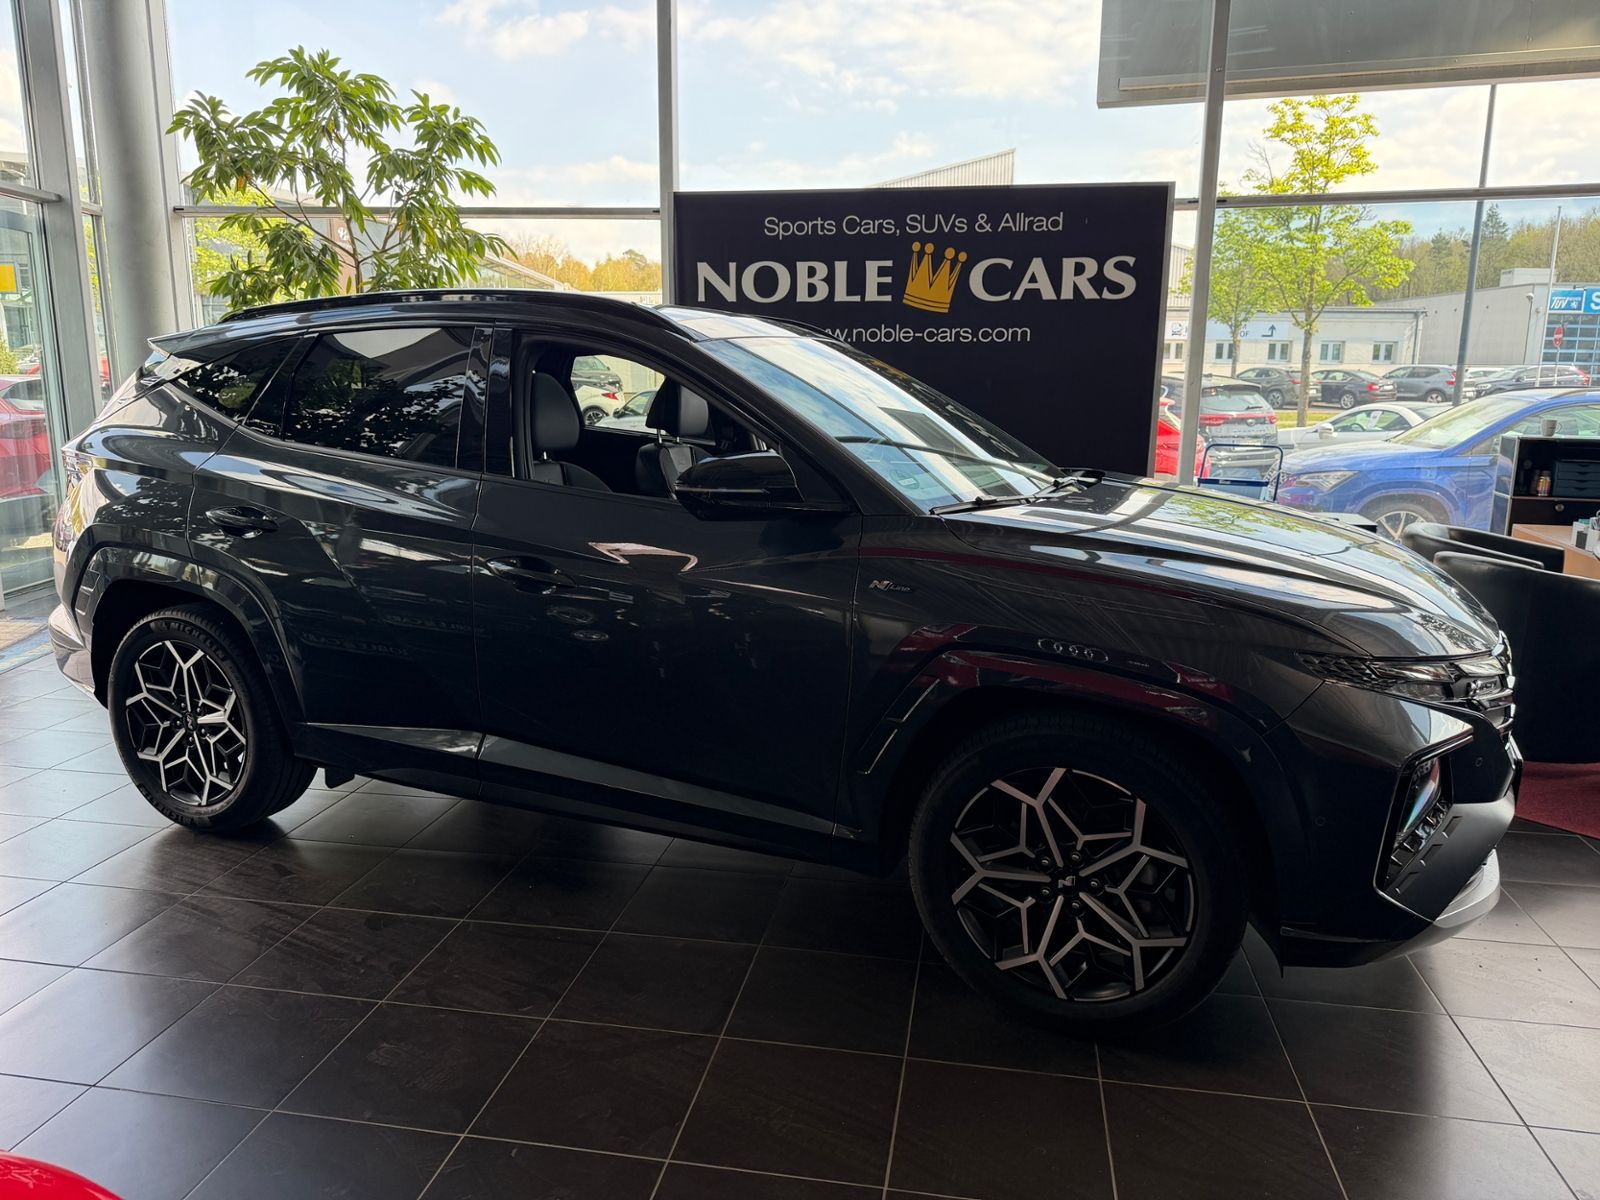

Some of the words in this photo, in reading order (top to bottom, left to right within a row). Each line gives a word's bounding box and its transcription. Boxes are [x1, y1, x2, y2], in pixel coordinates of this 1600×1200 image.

[764, 216, 837, 238] Sports
[842, 215, 901, 236] Cars,
[905, 213, 968, 234] SUVs
[974, 213, 993, 233] &
[997, 211, 1064, 232] Allrad
[696, 259, 894, 303] NOBLE
[968, 254, 1137, 302] CARS
[825, 322, 1031, 343] w.noble-cars.com
